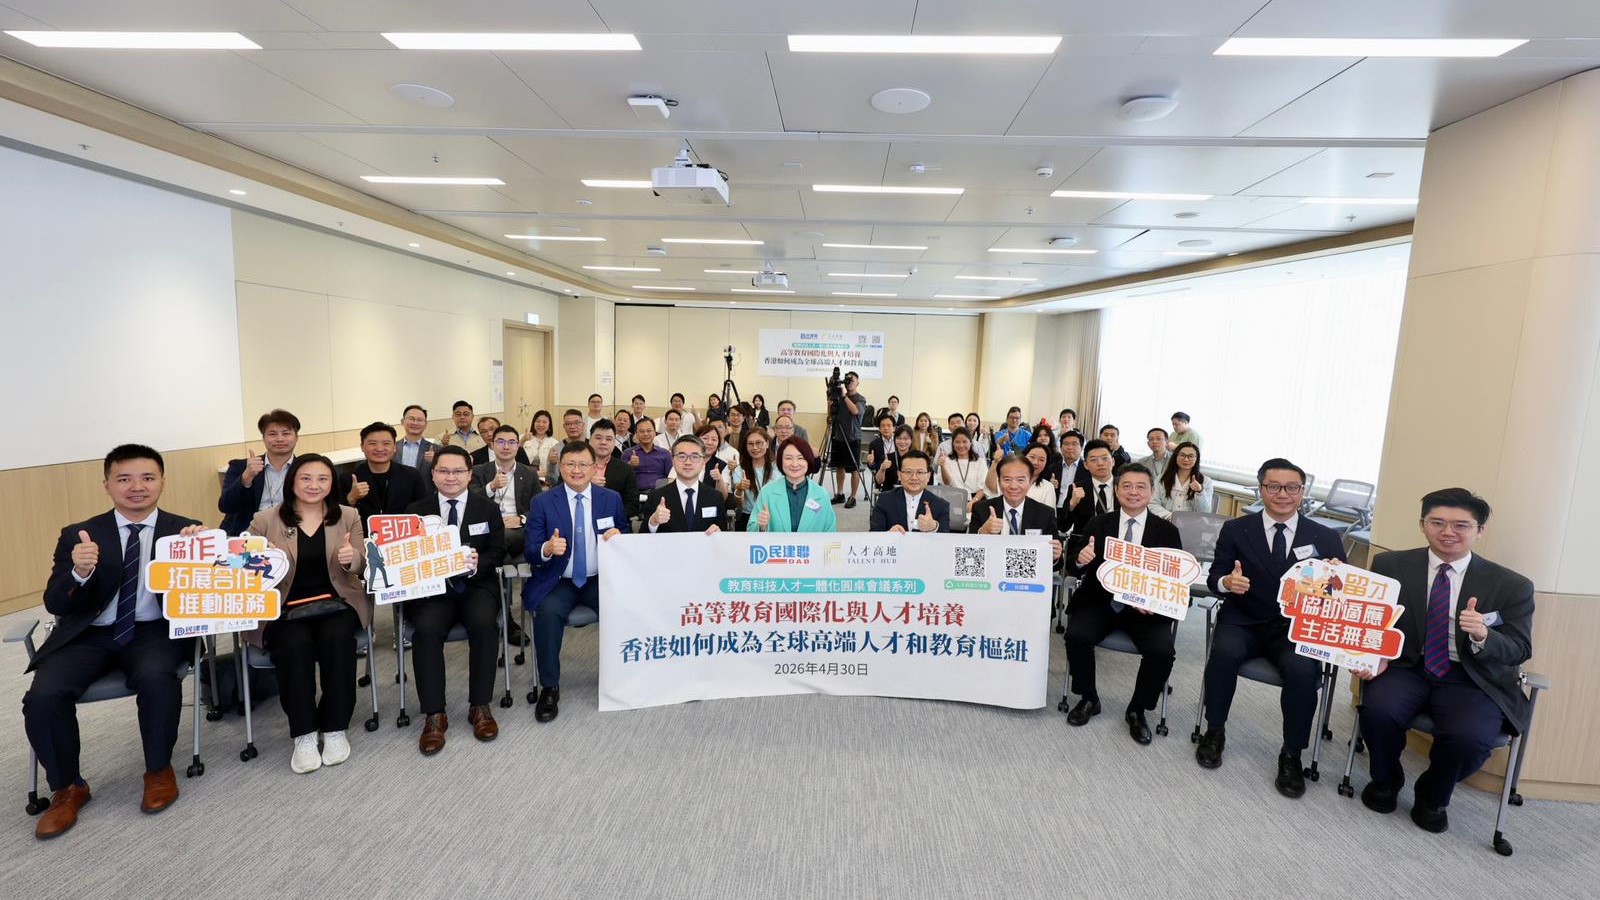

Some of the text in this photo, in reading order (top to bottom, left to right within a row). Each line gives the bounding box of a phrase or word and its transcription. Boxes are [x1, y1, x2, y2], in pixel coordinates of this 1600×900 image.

[381, 518, 412, 541] 引才
[169, 536, 215, 560] 協作
[769, 545, 810, 558] 民建聯
[847, 545, 897, 557] 人才高地
[1106, 538, 1181, 579] 匯聚高端
[168, 567, 257, 589] 拓展合作
[400, 551, 466, 586] 宣傳香港
[727, 579, 917, 594] 教育科技人才一體化圓桌會議系列
[1112, 566, 1188, 606] 成就未來
[1343, 573, 1389, 600] 留才
[179, 592, 265, 615] 推動服務
[680, 600, 966, 627] 高等教育國際化與人才培養
[1301, 595, 1385, 626] 協助適應
[620, 630, 1029, 663] 香港如何成為全球高端人才和教育樞紐
[1300, 618, 1385, 651] 生活無憂
[774, 662, 868, 676] 2026年4月30日
